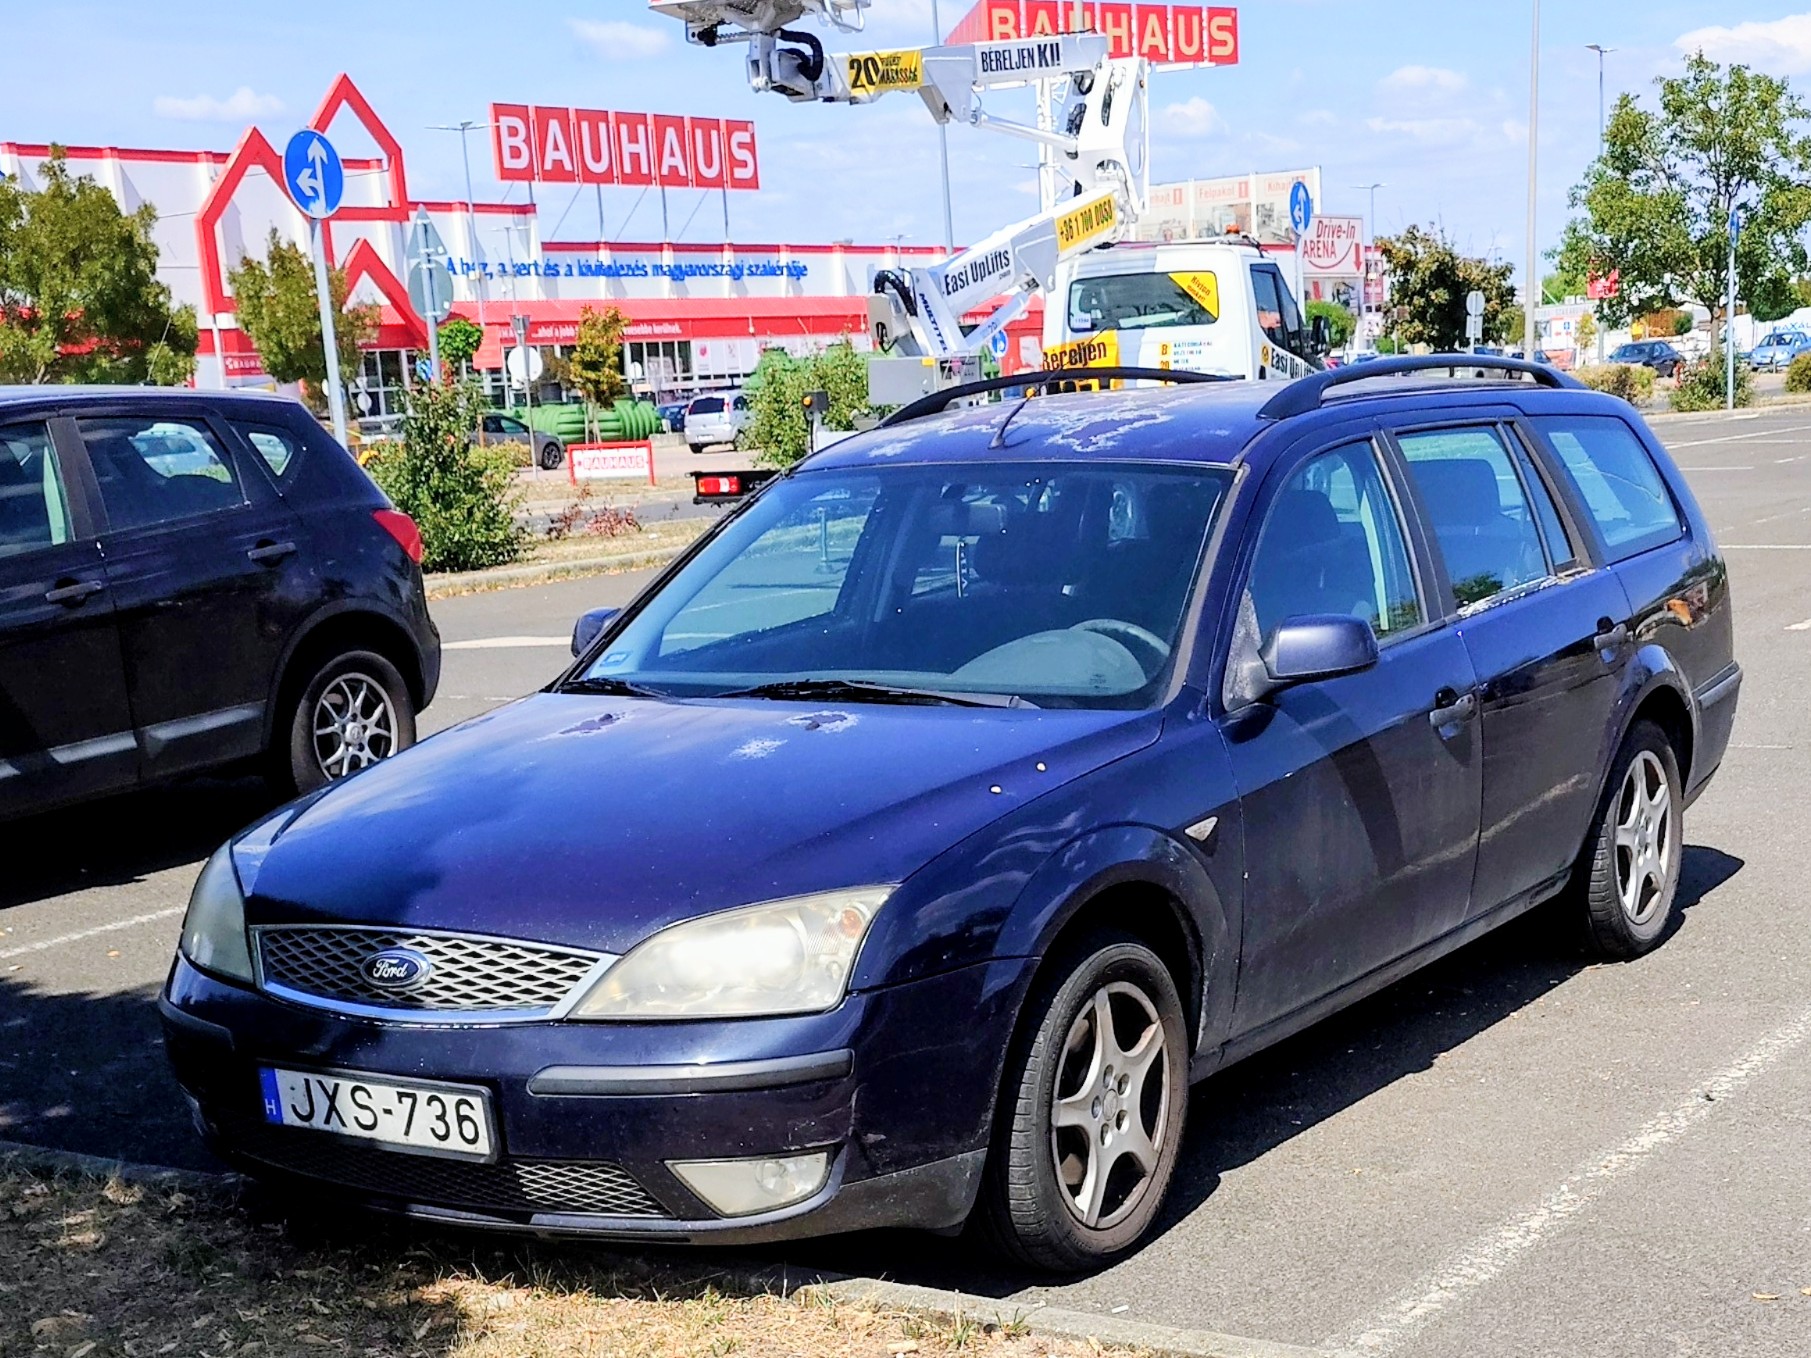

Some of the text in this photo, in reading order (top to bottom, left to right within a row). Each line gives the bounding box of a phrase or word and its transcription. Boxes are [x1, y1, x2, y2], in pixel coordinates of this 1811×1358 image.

[981, 42, 1060, 72] BÉRELJEN KI!
[849, 57, 880, 89] 20
[498, 115, 756, 180] BAUHAUS
[1317, 220, 1356, 239] Drive-In
[1303, 240, 1337, 259] ARENA
[447, 257, 457, 275] A
[543, 258, 560, 277] és
[564, 262, 574, 276] a
[652, 260, 744, 281] magyarországi
[944, 249, 1010, 296] Easi UpLifts
[919, 292, 948, 354] MULTITEL
[583, 455, 645, 470] BAUHAUS
[372, 958, 408, 978] Ford
[264, 1077, 481, 1146] H JXS-736
